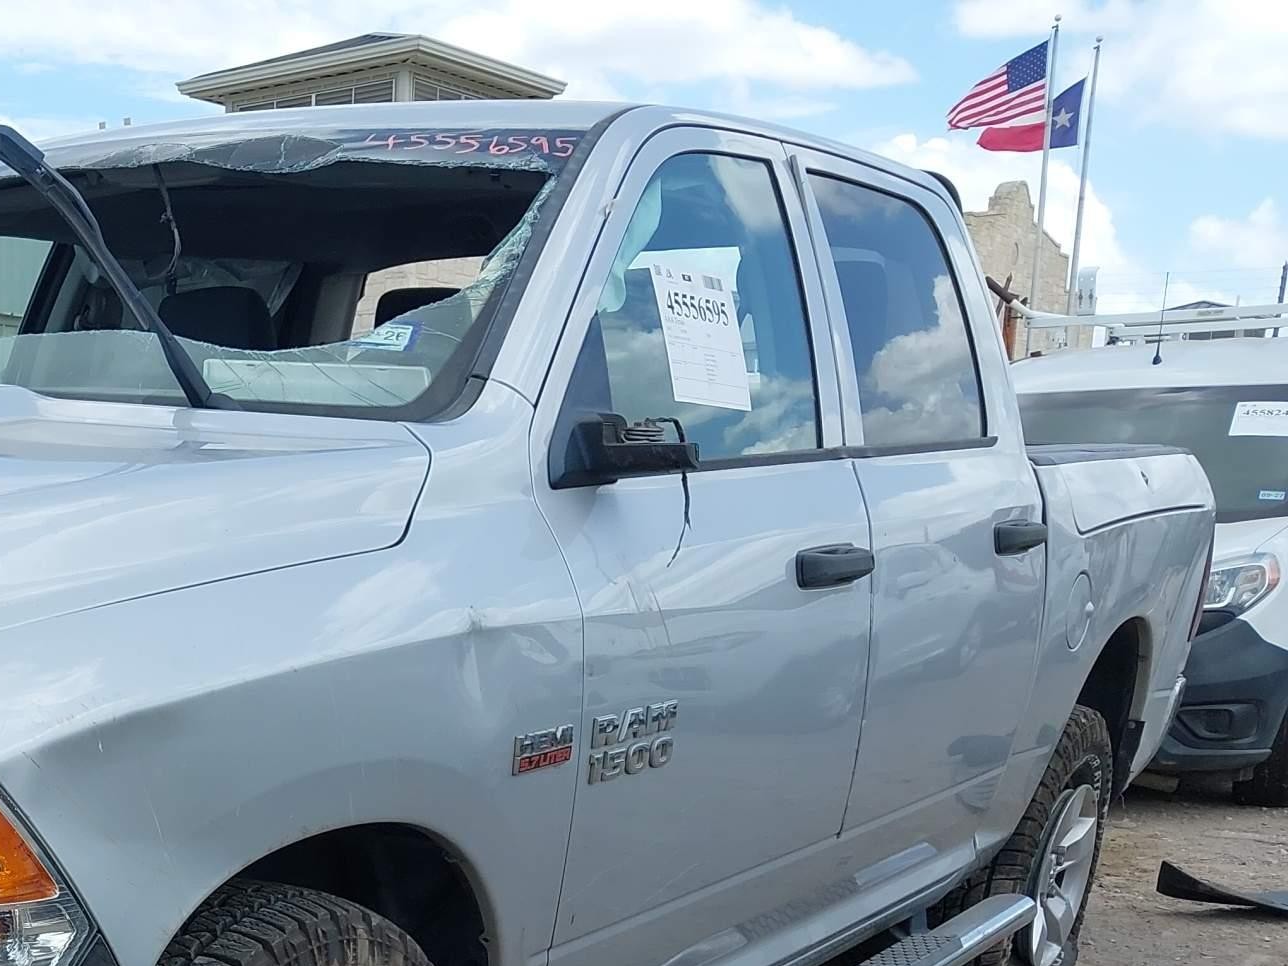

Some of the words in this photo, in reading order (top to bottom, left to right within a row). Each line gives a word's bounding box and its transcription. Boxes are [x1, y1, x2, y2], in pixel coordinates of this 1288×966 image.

[364, 133, 577, 157] 45556595
[666, 288, 729, 327] 45556595
[513, 724, 574, 758] HEMI
[591, 699, 678, 749] RAM
[587, 736, 674, 785] 1500
